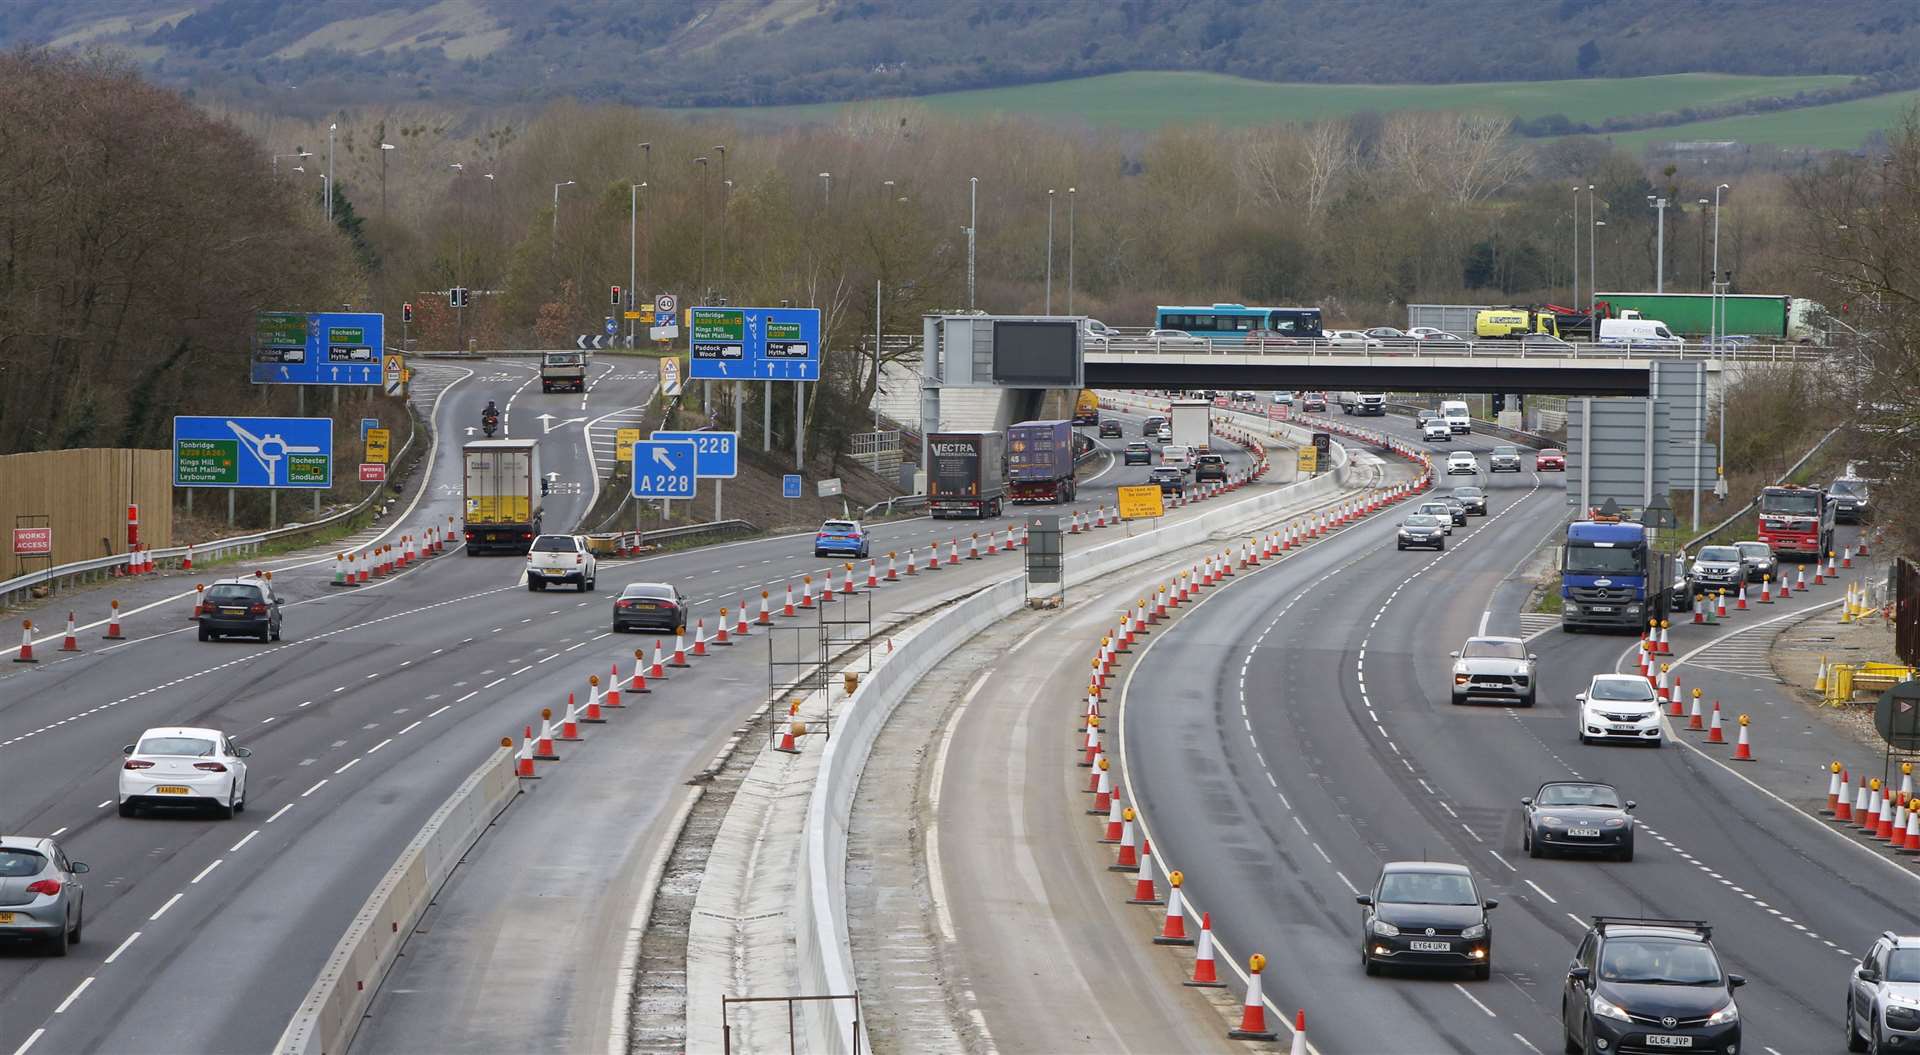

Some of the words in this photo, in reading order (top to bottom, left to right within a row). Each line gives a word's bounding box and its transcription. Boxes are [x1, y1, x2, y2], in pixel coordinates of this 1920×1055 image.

[712, 332, 734, 340] Malling
[180, 441, 215, 449] Tonbridge
[931, 443, 975, 457] VECTRA
[180, 458, 199, 467] Kings
[201, 458, 215, 466] Hill
[290, 456, 326, 464] Rochester
[199, 466, 226, 475] Malling
[180, 473, 216, 481] Leybourne
[290, 473, 324, 481] Snodland
[16, 541, 48, 549] ACCESS
[1413, 942, 1432, 950] EY64
[1433, 943, 1448, 951] URX
[1649, 1035, 1670, 1046] GL64
[1673, 1036, 1689, 1046] JVP
